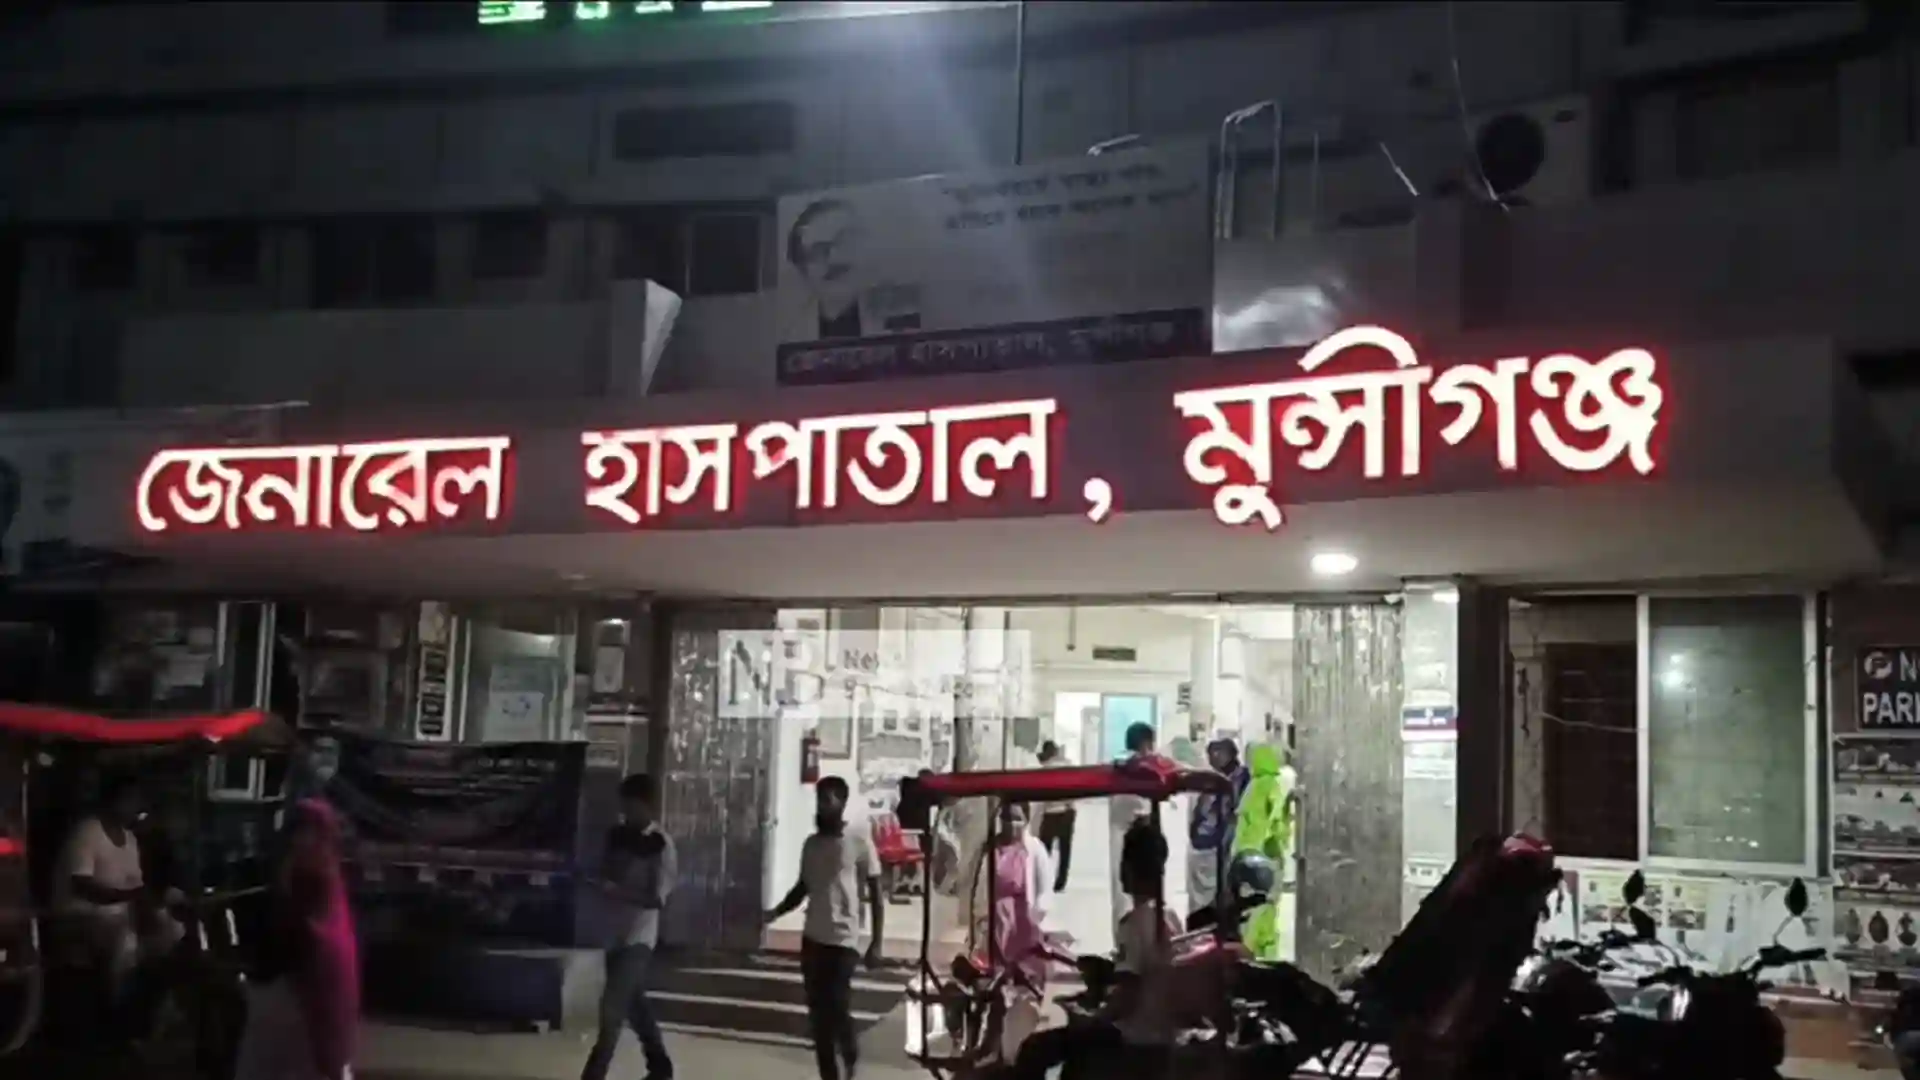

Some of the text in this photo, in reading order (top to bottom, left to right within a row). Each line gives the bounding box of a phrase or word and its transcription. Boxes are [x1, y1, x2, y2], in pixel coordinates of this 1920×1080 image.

[137, 436, 510, 531] জেনারেল
[1173, 326, 1663, 529] মুন্সীগঞ্জ
[1898, 650, 1920, 682] N
[1862, 691, 1920, 725] PAR
